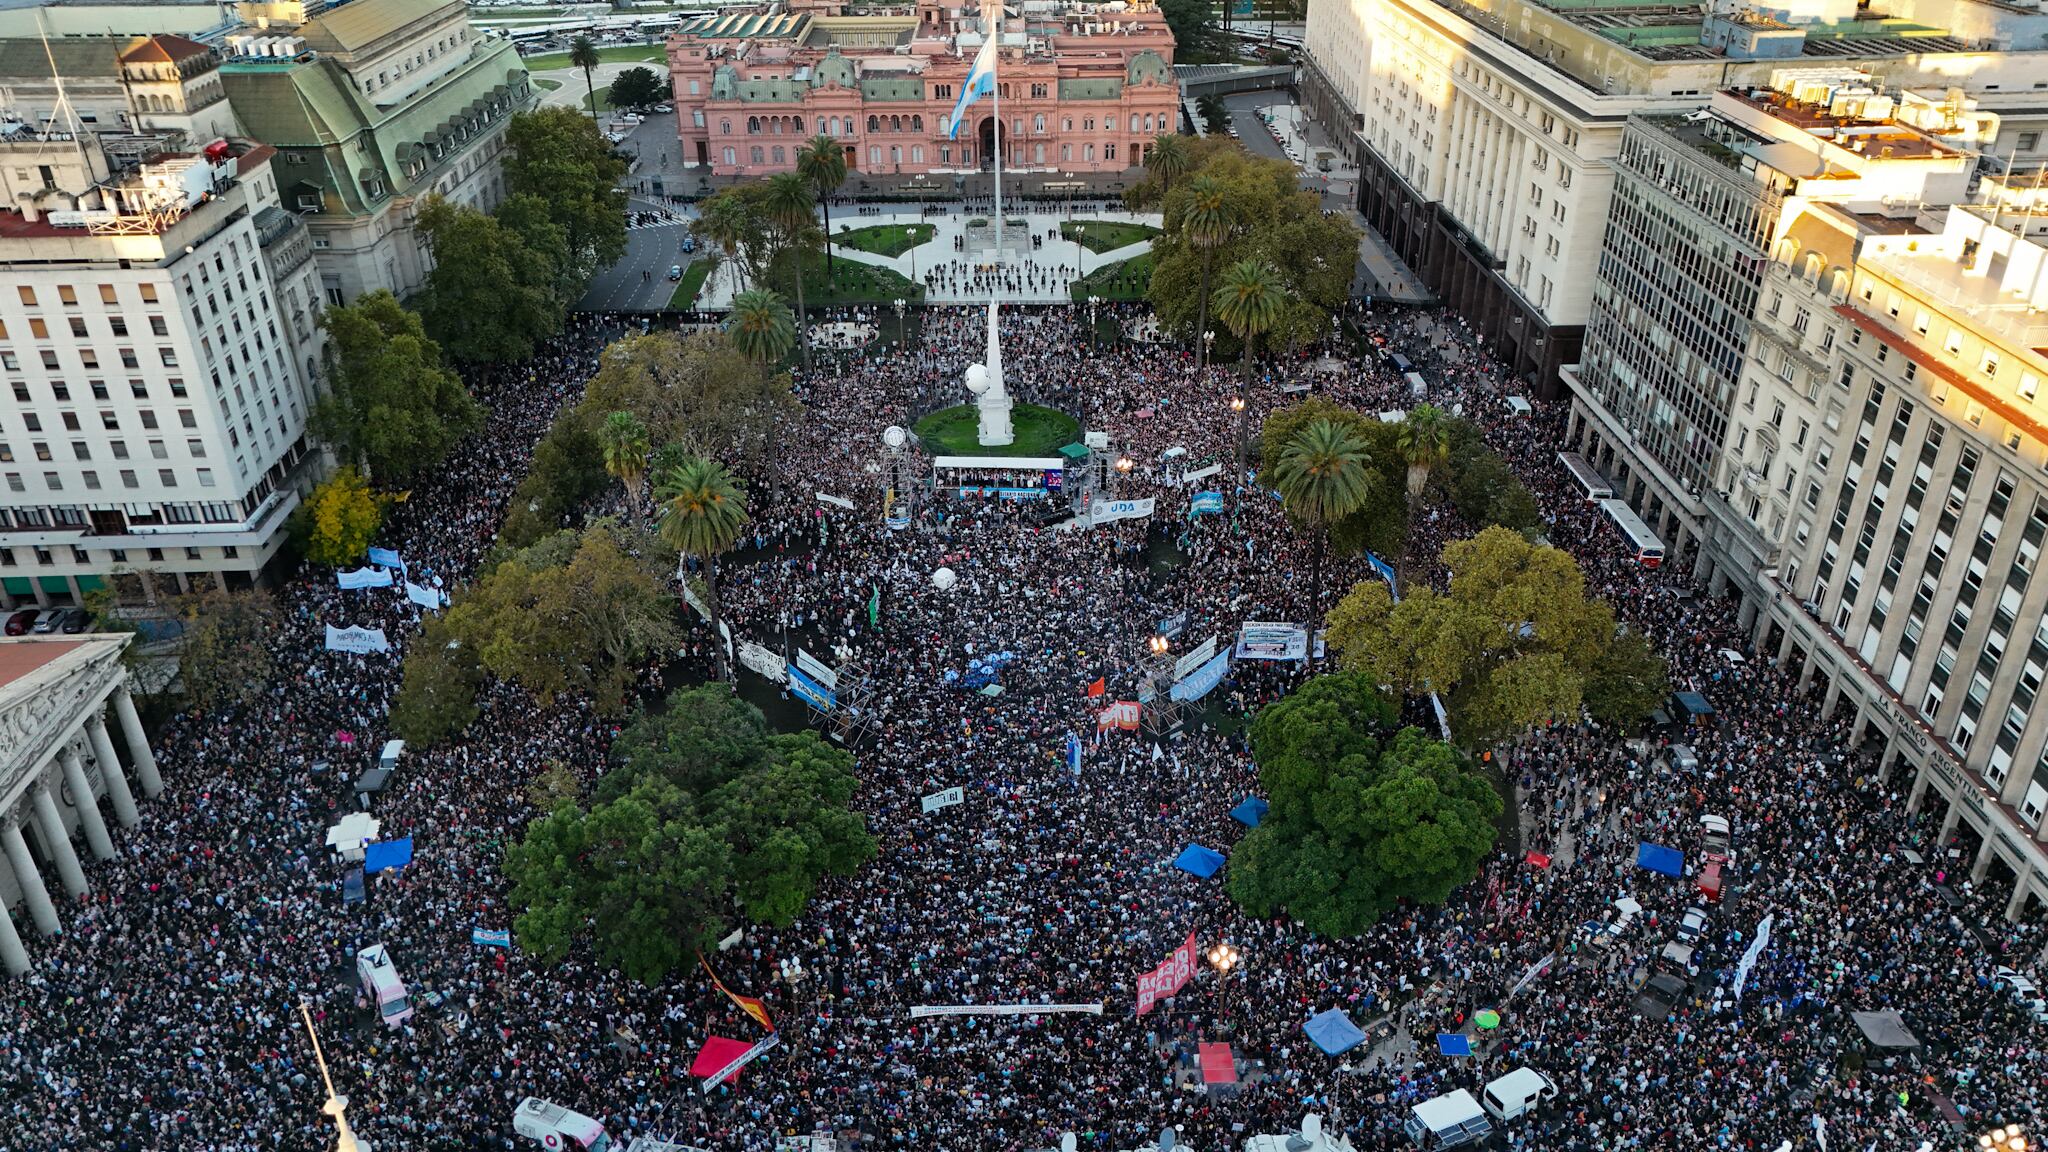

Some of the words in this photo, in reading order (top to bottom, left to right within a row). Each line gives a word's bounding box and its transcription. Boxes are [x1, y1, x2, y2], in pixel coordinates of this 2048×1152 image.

[1879, 695, 1889, 710] LA
[1893, 709, 1927, 747] FRANCO
[1930, 750, 1985, 808] ARGENTINA
